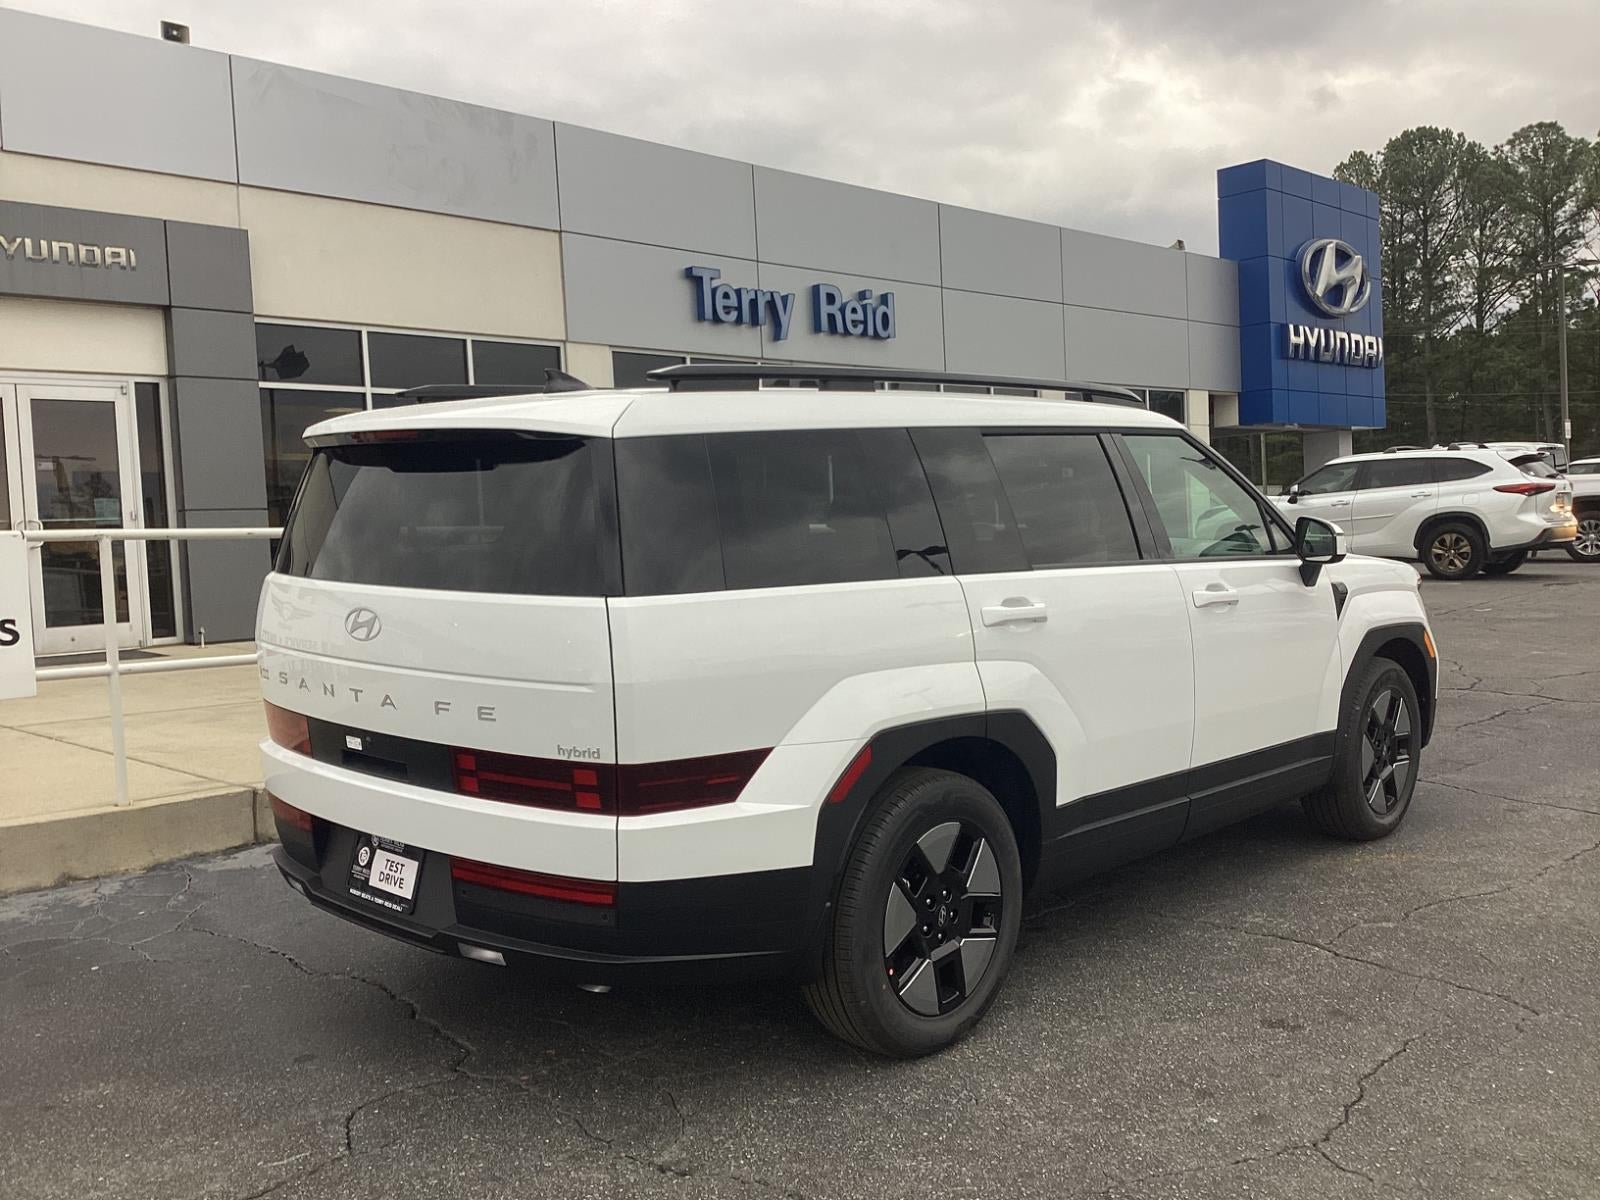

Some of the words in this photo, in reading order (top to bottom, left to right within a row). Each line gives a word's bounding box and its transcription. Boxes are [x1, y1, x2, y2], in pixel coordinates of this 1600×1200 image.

[0, 235, 137, 270] YUNDAI
[685, 266, 795, 341] Terry
[811, 283, 896, 339] Reid
[1288, 323, 1384, 368] HYUNDAI
[278, 672, 398, 711] SANTA
[434, 701, 497, 722] FE
[557, 744, 600, 760] hybrid
[378, 871, 405, 889] DRIVE
[384, 858, 405, 875] TEST
